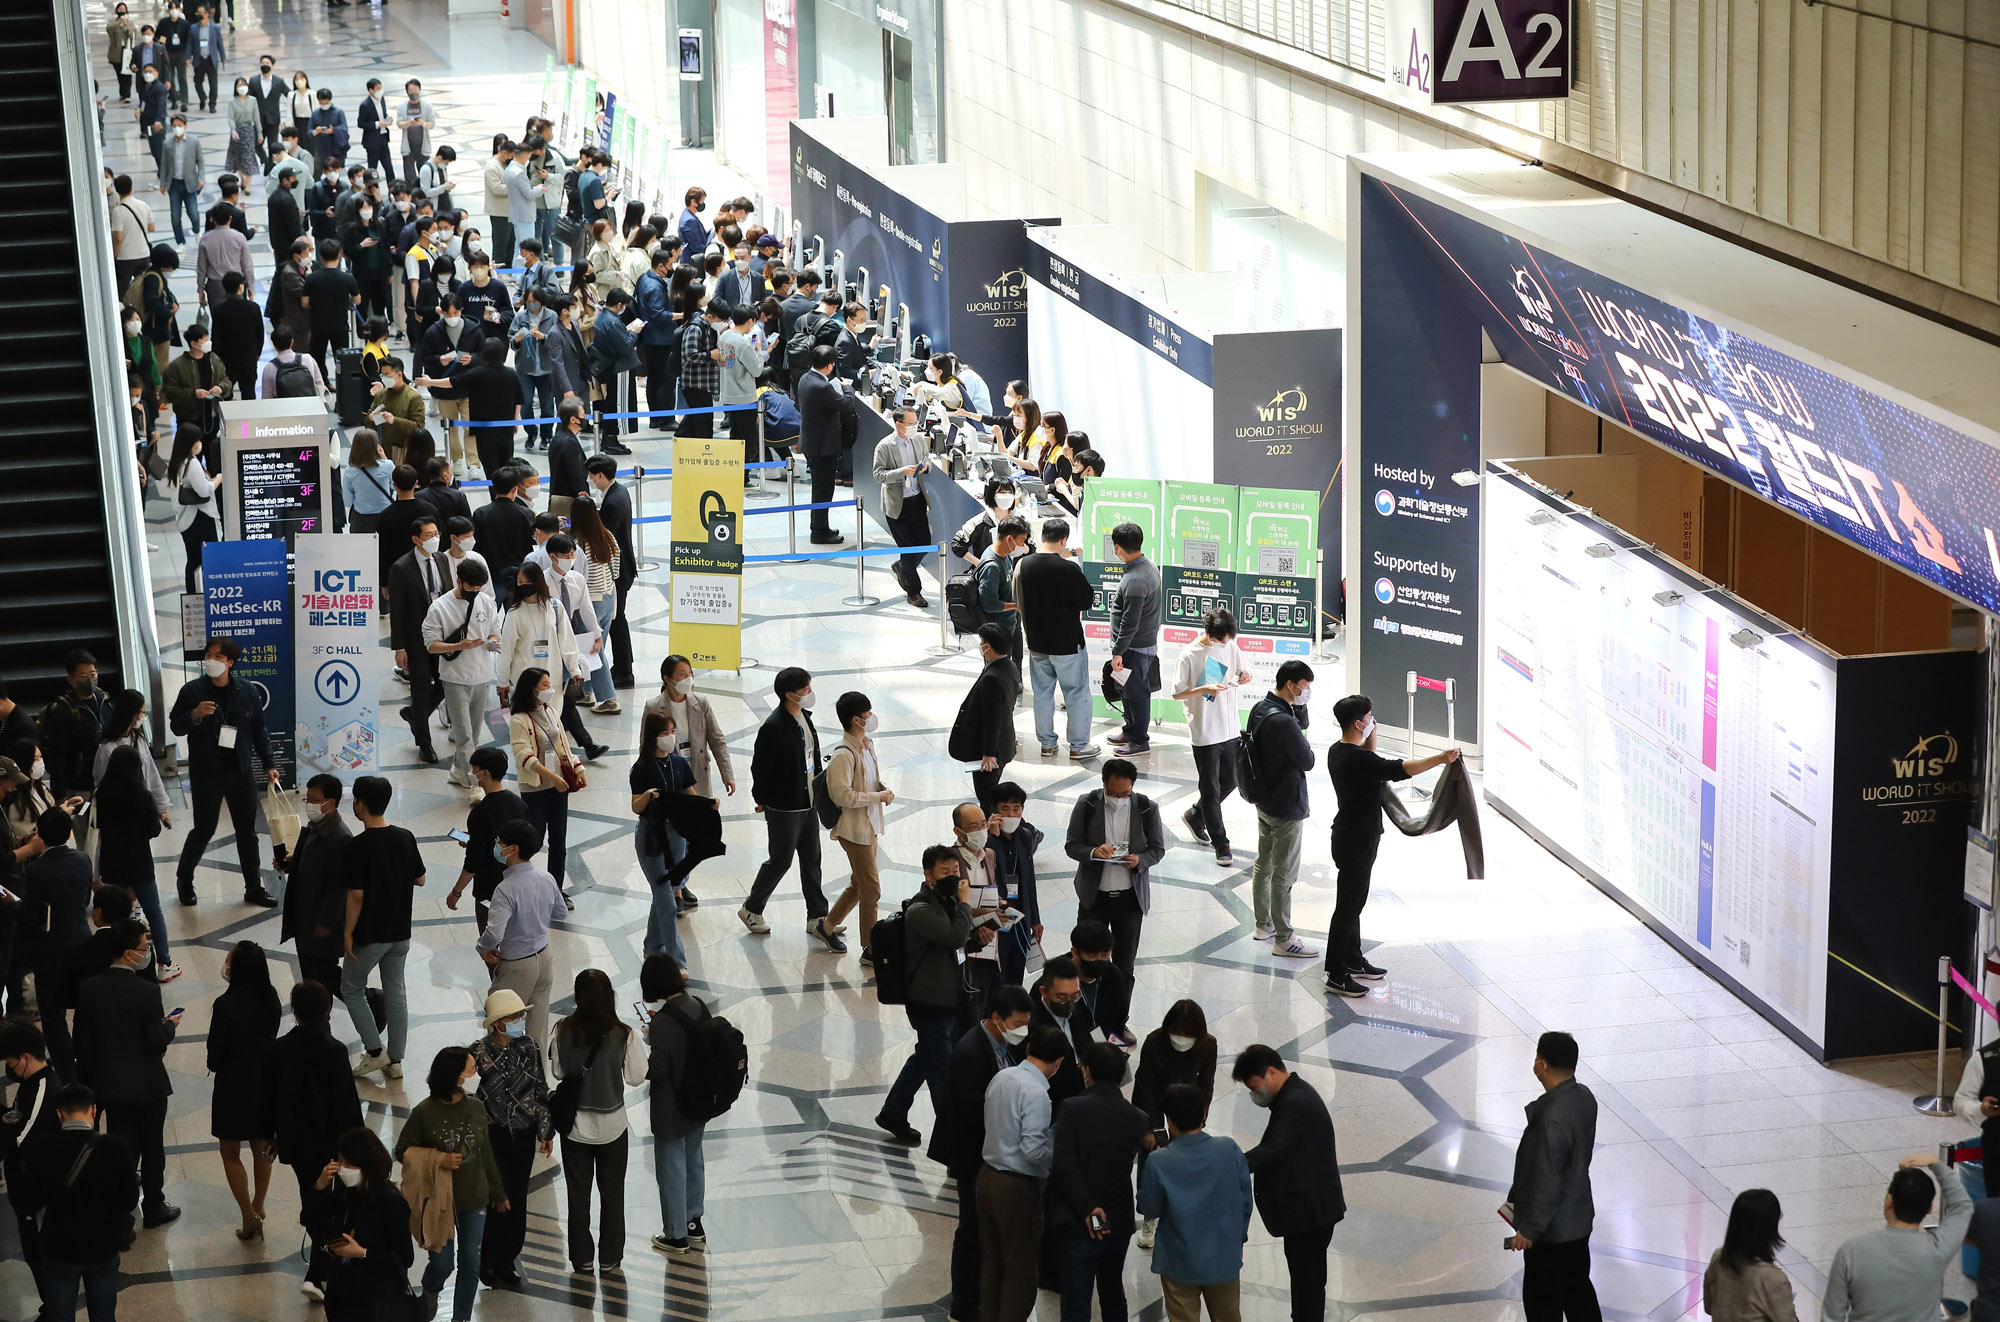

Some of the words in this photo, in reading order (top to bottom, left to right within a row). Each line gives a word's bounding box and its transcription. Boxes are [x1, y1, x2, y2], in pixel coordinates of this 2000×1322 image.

[1442, 0, 1562, 82] A2
[1393, 66, 1405, 85] Hall
[1407, 28, 1430, 93] A2
[987, 285, 1020, 298] WIS
[966, 302, 1000, 312] WORLD
[1014, 300, 1028, 310] SH
[1516, 290, 1553, 324] WIS
[994, 318, 1016, 327] 2022
[1171, 328, 1182, 345] Press
[1517, 314, 1551, 342] WORLD
[1557, 333, 1589, 360] SHOW
[1153, 335, 1168, 356] Exhibitor
[1170, 345, 1178, 364] Only
[1577, 287, 1684, 370] WORLD
[1708, 346, 1816, 431] SHOW
[1559, 359, 1586, 384] 2022
[1259, 407, 1297, 422] WIS
[1615, 351, 1767, 474] 2022
[256, 425, 314, 437] information
[1236, 426, 1274, 438] WORLD
[1290, 424, 1323, 435] SHOW
[299, 450, 313, 461] 4F
[1266, 444, 1292, 456] 2022
[1374, 463, 1416, 484] Hosted
[1420, 470, 1435, 489] by
[300, 485, 314, 496] 3F
[1100, 490, 1118, 498] 모바일
[1180, 494, 1198, 502] 모바일
[1199, 496, 1211, 504] 등록
[1212, 496, 1224, 504] 안내
[1256, 501, 1275, 509] 모바일
[1277, 502, 1290, 510] 등록
[1292, 502, 1305, 510] 안내
[1398, 496, 1468, 518] 과학기술정보통신부
[301, 520, 316, 531] 2F
[675, 557, 714, 567] Exhibitor
[717, 560, 738, 569] badge
[1374, 551, 1438, 576] Supported
[1442, 563, 1456, 582] by
[314, 570, 361, 592] ICT
[209, 586, 243, 598] 2022
[1398, 586, 1450, 604] 산업통상자원부
[210, 600, 281, 614] NetSec-KR
[302, 594, 373, 609] 기술사업화
[680, 598, 706, 606] 참가업체
[211, 619, 252, 628] 사이버보안과
[309, 612, 366, 626] 페스티벌
[1374, 616, 1399, 634] nipa
[212, 629, 232, 637] 디지털
[313, 646, 324, 654] 3F
[326, 646, 334, 654] C
[337, 646, 362, 654] HALL
[1894, 758, 1944, 778] WIS
[1862, 785, 1914, 801] WORLD
[1934, 780, 1980, 796] SHOW
[1902, 809, 1936, 824] 2022
